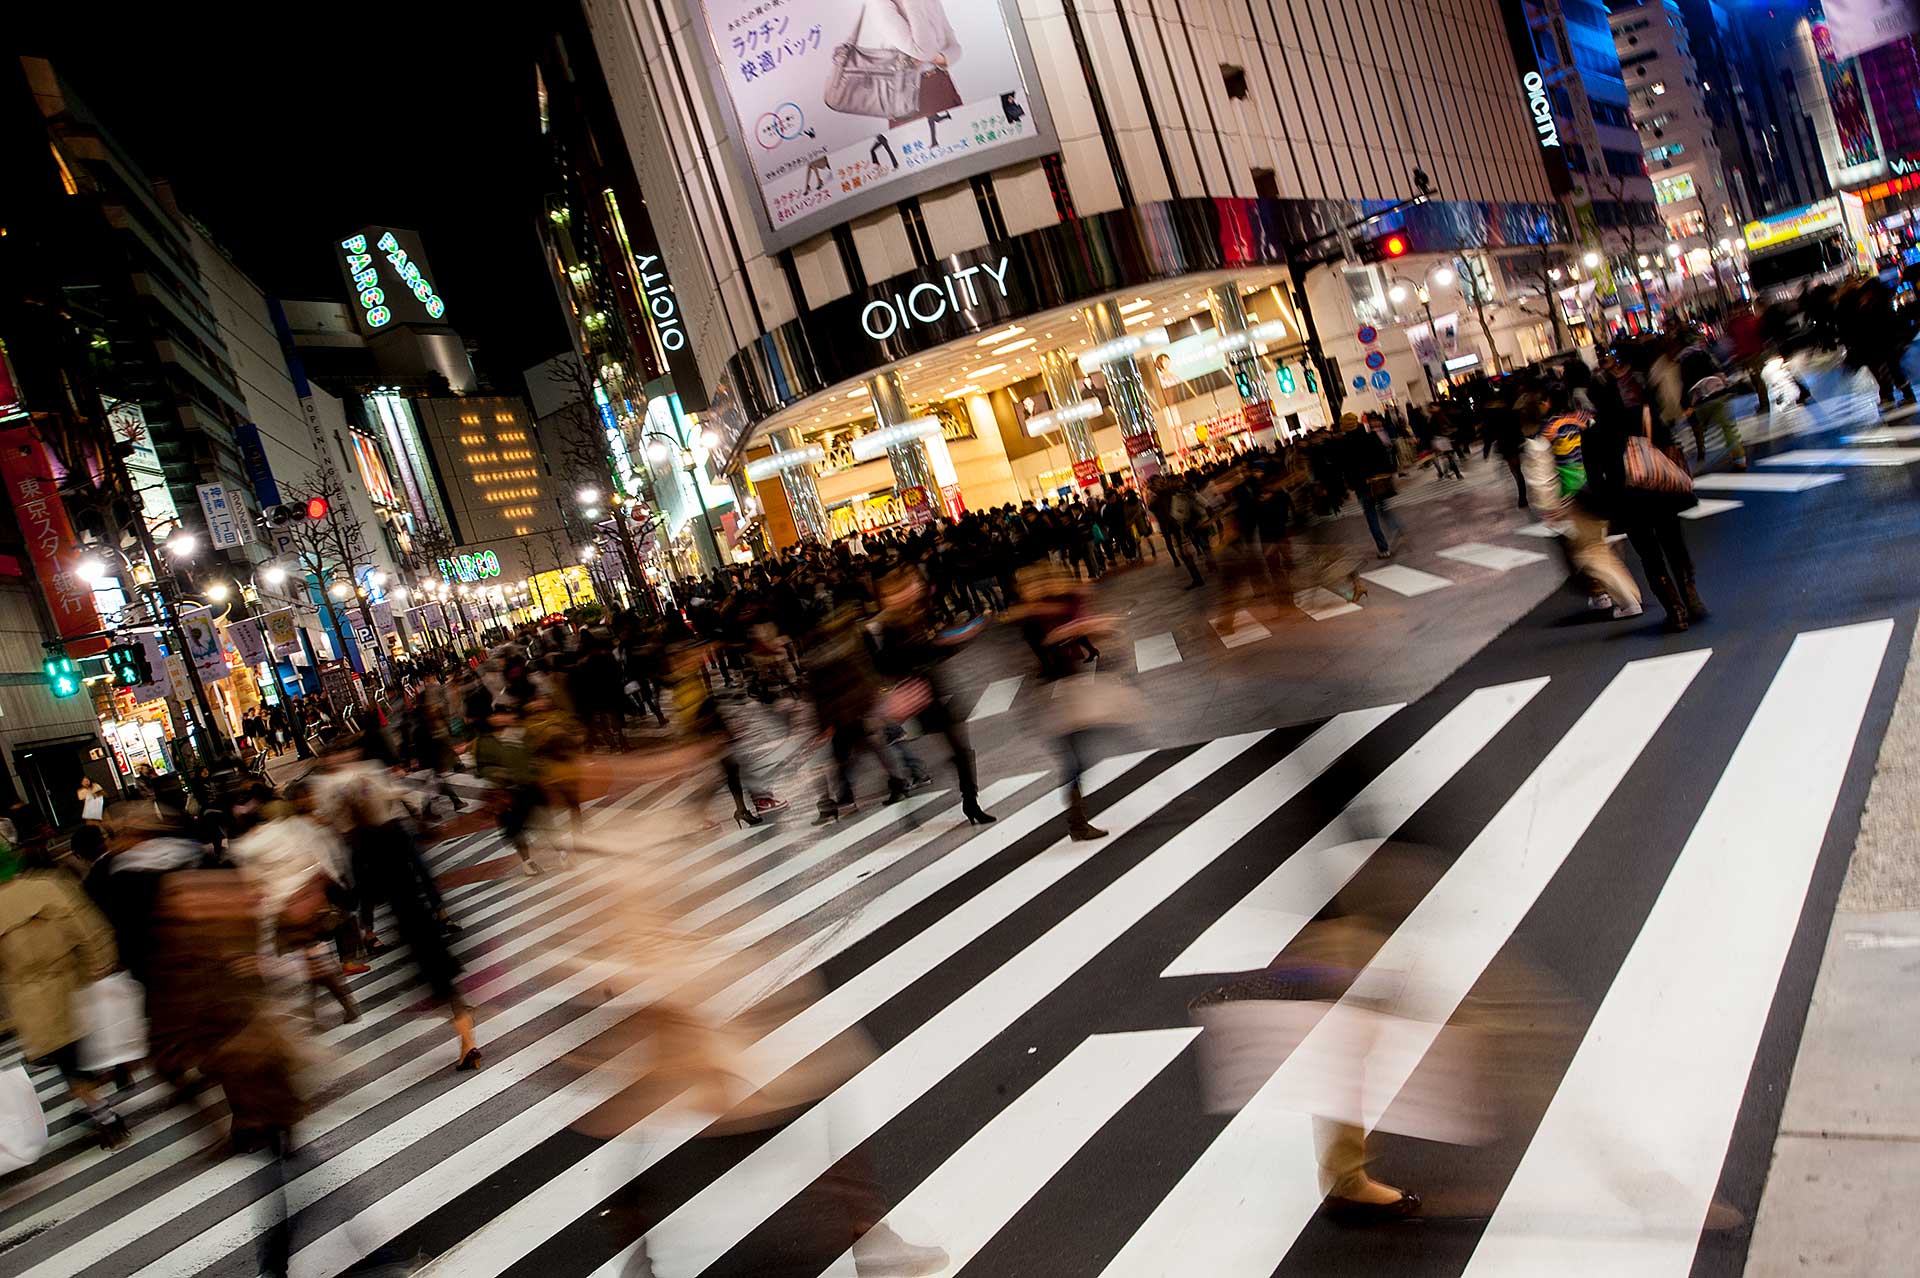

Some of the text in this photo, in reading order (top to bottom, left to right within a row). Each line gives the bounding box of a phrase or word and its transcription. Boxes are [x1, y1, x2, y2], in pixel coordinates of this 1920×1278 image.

[732, 15, 789, 58] ラクチン
[740, 24, 821, 82] 快適バッグ
[341, 234, 391, 327] PARCO
[377, 231, 445, 319] PARCO
[305, 403, 336, 476] OPENING
[17, 478, 82, 615] 東京スター銀行
[277, 537, 291, 553] P
[357, 628, 371, 643] P
